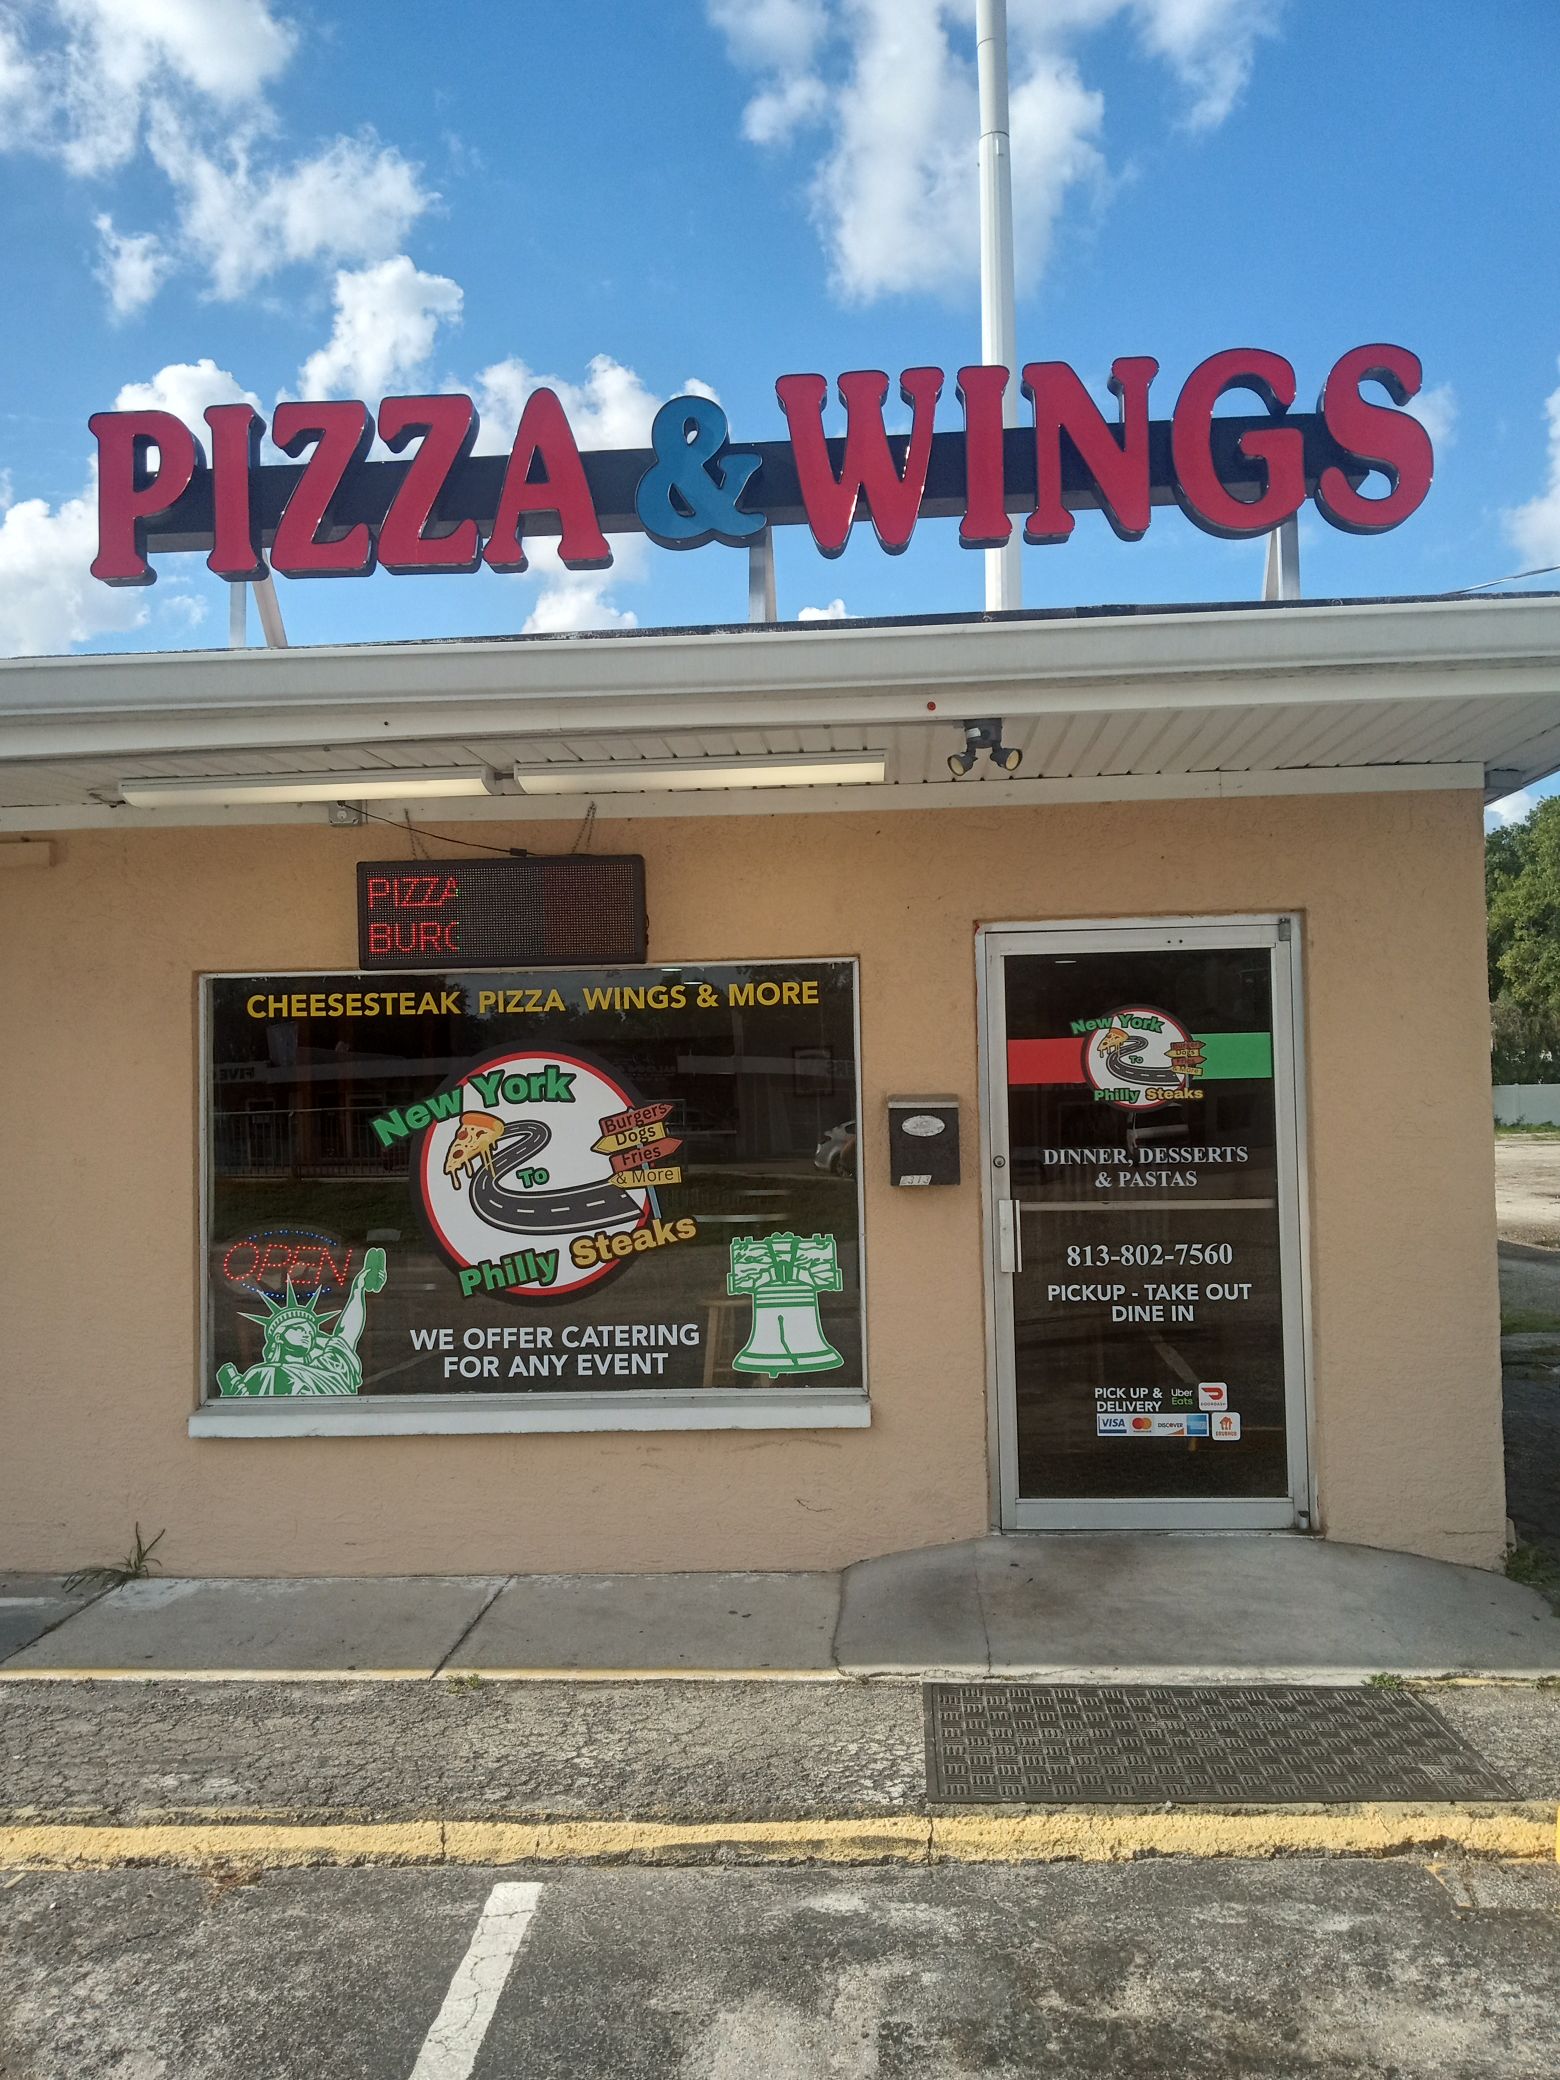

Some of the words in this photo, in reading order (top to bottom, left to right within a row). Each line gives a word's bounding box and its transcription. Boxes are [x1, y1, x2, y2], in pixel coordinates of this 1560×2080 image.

[88, 387, 613, 586] PIZZA
[635, 395, 767, 549] &
[775, 343, 1434, 559] WINGS
[246, 991, 461, 1018] CHEESESTEAK
[478, 988, 566, 1014] PIZZA
[583, 985, 687, 1011] WINGS
[696, 984, 718, 1008] &
[728, 981, 819, 1007] MORE
[1070, 1016, 1114, 1034] New
[1117, 1014, 1165, 1034] York
[1128, 1055, 1144, 1064] To
[1093, 1088, 1141, 1103] Philly
[1145, 1087, 1204, 1101] Steaks
[372, 1085, 464, 1147] New
[468, 1065, 577, 1108] York
[604, 1103, 667, 1134] Burgers
[615, 1126, 656, 1146] Dogs
[621, 1146, 662, 1166] Fries
[1043, 1148, 1133, 1168] DINNER,
[1139, 1147, 1249, 1164] DESSERTS
[515, 1167, 549, 1188] To
[616, 1171, 627, 1184] &
[632, 1168, 674, 1183] More
[1095, 1173, 1112, 1188] &
[1118, 1170, 1198, 1188] PASTAS
[223, 1241, 353, 1287] OPEN
[458, 1248, 559, 1297] Philly
[569, 1216, 697, 1269] Steaks
[1066, 1243, 1233, 1267] 813-802-7560
[1048, 1285, 1126, 1301] PICKUP
[1144, 1284, 1199, 1301] TAKE
[1205, 1283, 1252, 1300] OUT
[1112, 1305, 1165, 1322] DINE
[1172, 1305, 1194, 1322] IN
[410, 1328, 454, 1350] WE
[463, 1327, 553, 1350] OFFER
[561, 1324, 700, 1348] CATERING
[444, 1356, 500, 1378] FOR
[508, 1354, 568, 1377] ANY
[577, 1352, 668, 1376] EVENT
[1095, 1387, 1126, 1399] PICK
[1130, 1387, 1149, 1399] UP
[1152, 1387, 1163, 1399] &
[1171, 1388, 1193, 1397] Uber
[1171, 1397, 1193, 1406] Eats
[1096, 1400, 1162, 1412] DELIVERY
[1102, 1418, 1126, 1427] VISA
